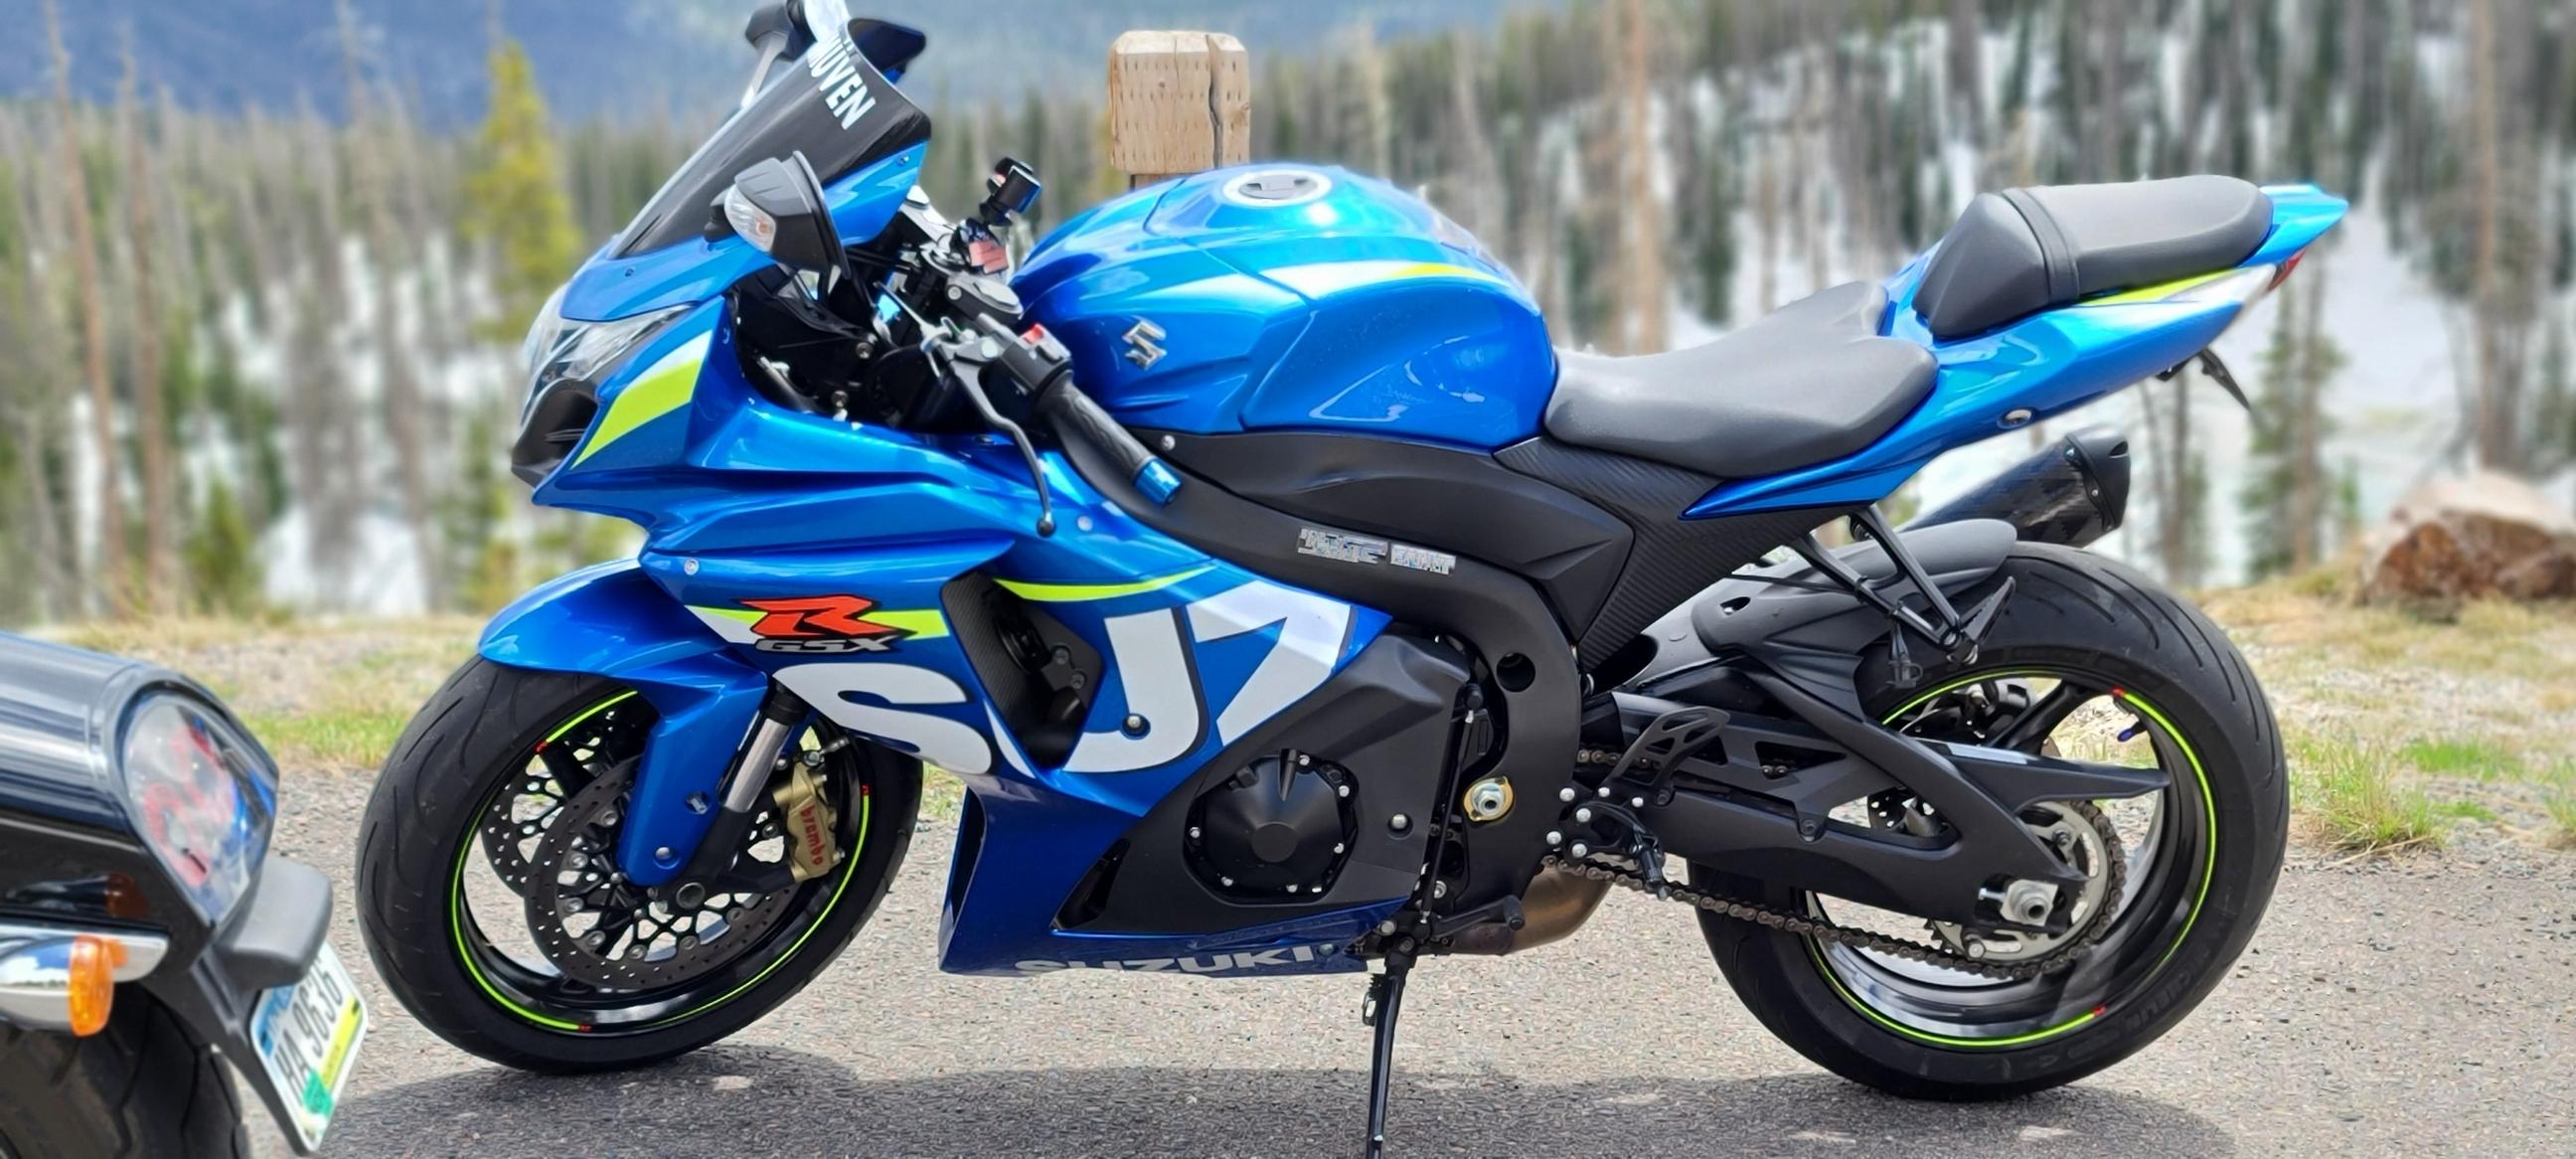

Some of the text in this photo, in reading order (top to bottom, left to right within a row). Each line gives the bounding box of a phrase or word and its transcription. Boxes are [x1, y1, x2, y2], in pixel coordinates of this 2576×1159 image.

[739, 594, 896, 637] R
[755, 634, 899, 653] GSX
[801, 803, 827, 866] brembo
